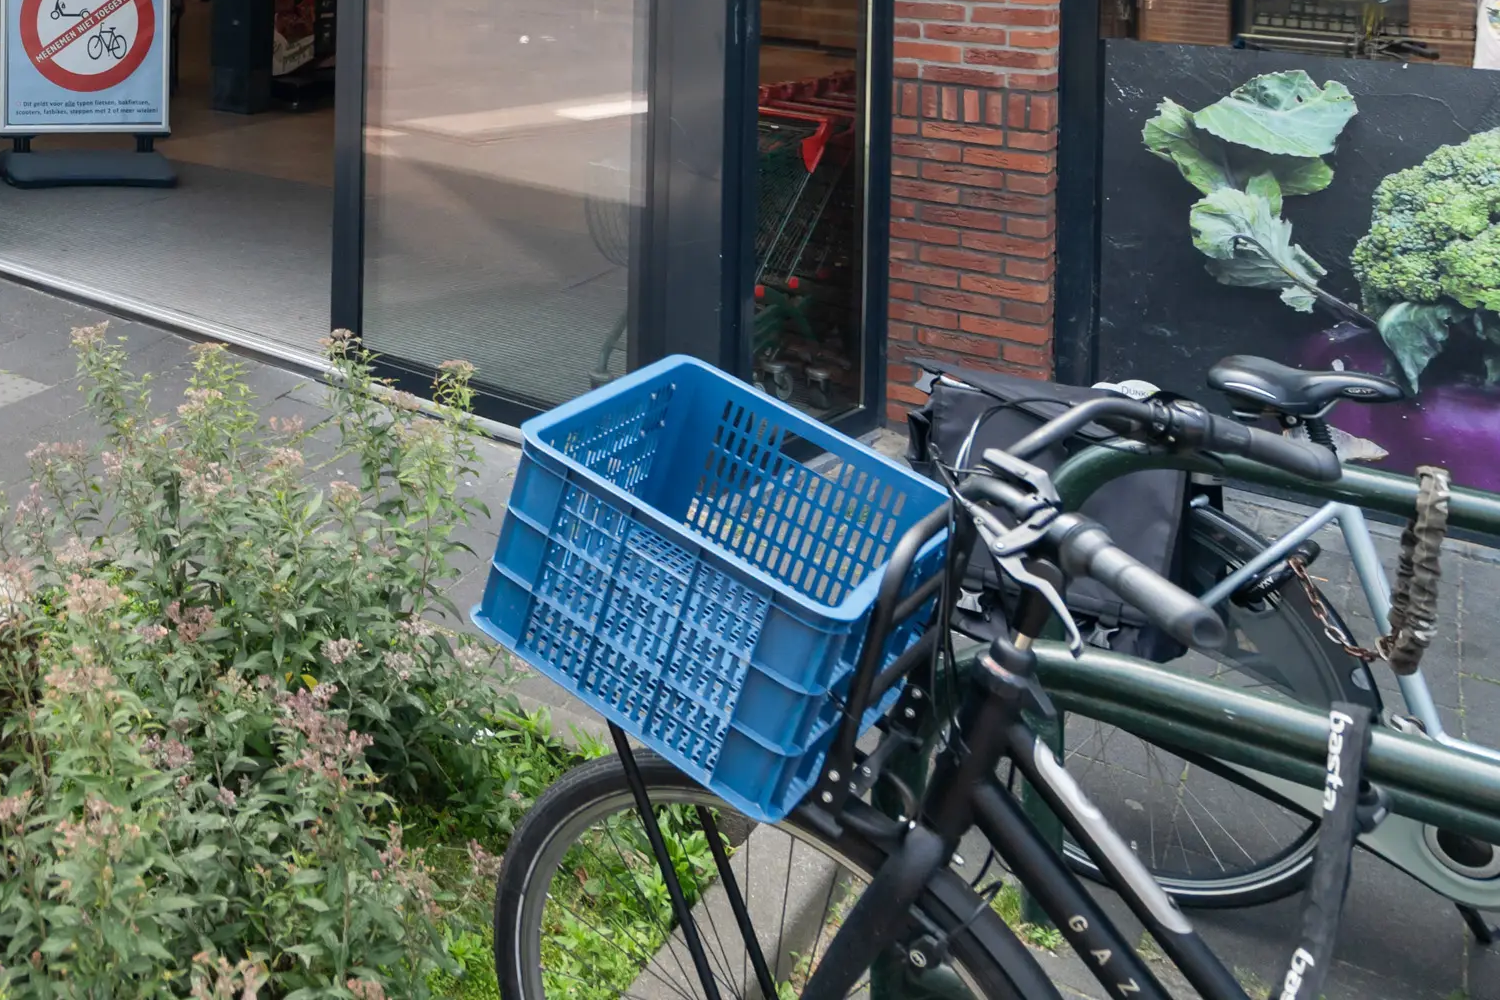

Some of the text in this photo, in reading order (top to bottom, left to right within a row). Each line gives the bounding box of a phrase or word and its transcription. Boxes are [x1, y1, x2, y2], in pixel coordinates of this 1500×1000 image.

[36, 31, 77, 62] MEENEMEN
[77, 18, 95, 36] NIET
[1257, 575, 1274, 590] AXA
[1322, 709, 1354, 811] basta
